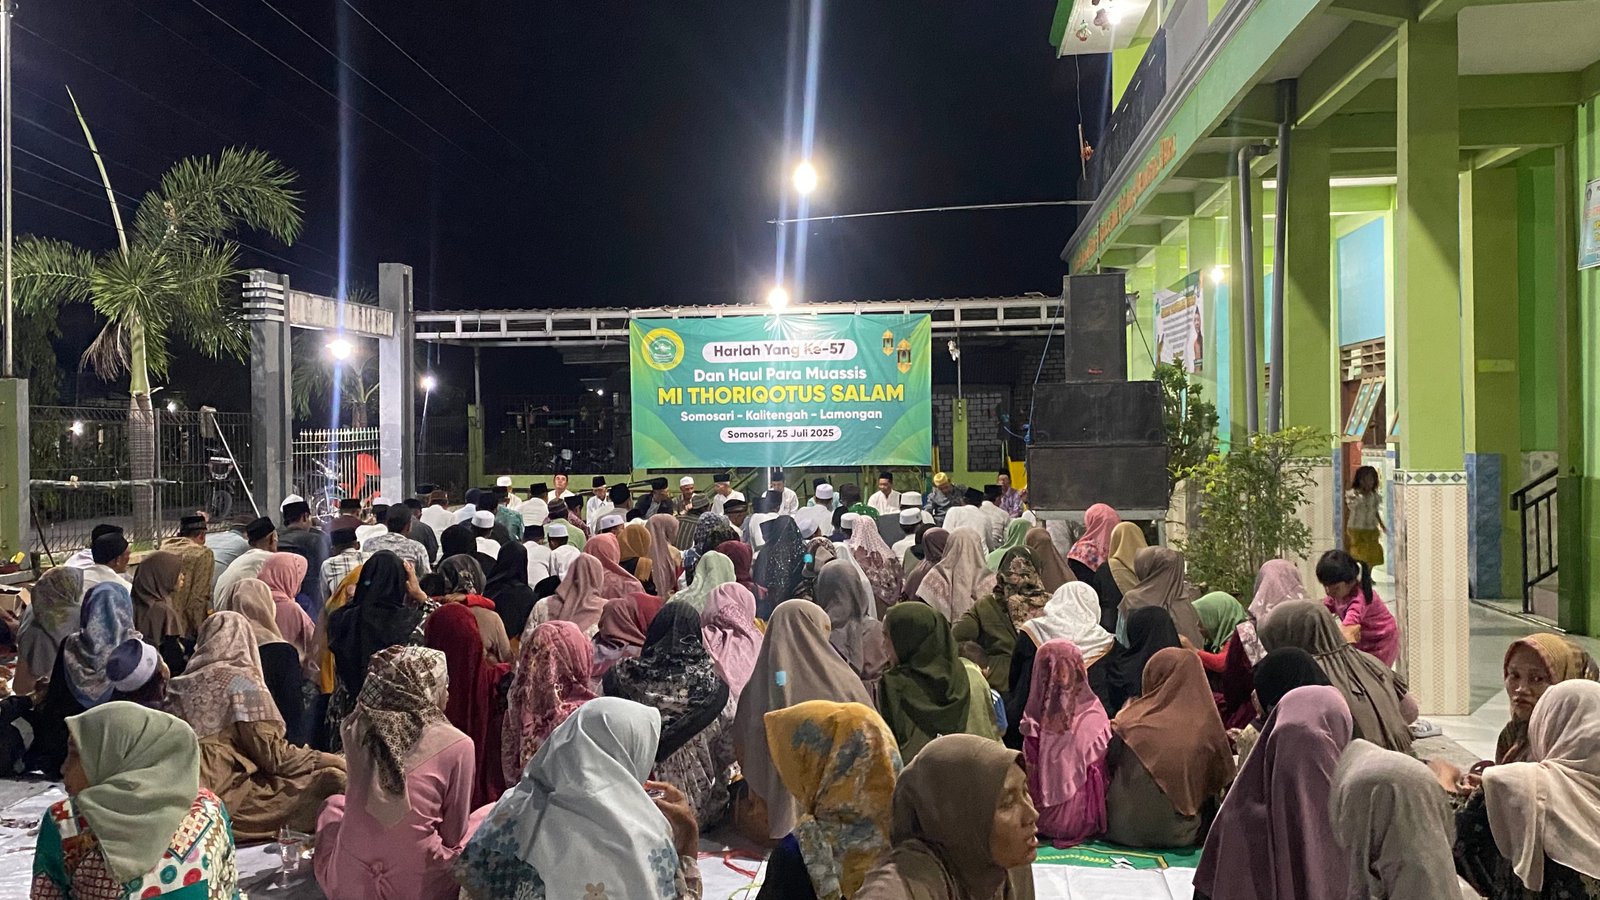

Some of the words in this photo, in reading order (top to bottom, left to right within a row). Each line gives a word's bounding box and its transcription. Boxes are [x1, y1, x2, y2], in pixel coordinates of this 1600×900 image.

[714, 344, 760, 357] Harlah
[764, 343, 800, 358] Yang
[804, 342, 846, 355] Ke-57
[694, 369, 725, 382] Dan
[728, 367, 762, 381] Haul
[766, 367, 801, 381] Para
[806, 366, 867, 380] Muassis
[658, 387, 683, 405] MI
[687, 385, 826, 404] THORIQOTUS
[831, 384, 904, 402] SALAM
[680, 410, 735, 422] Somosari
[746, 409, 808, 422] Kalitengah
[820, 409, 882, 421] Lamongan
[727, 429, 774, 439] Somosari,
[777, 429, 788, 438] 25
[791, 429, 808, 437] Juli
[810, 428, 834, 437] 2025
